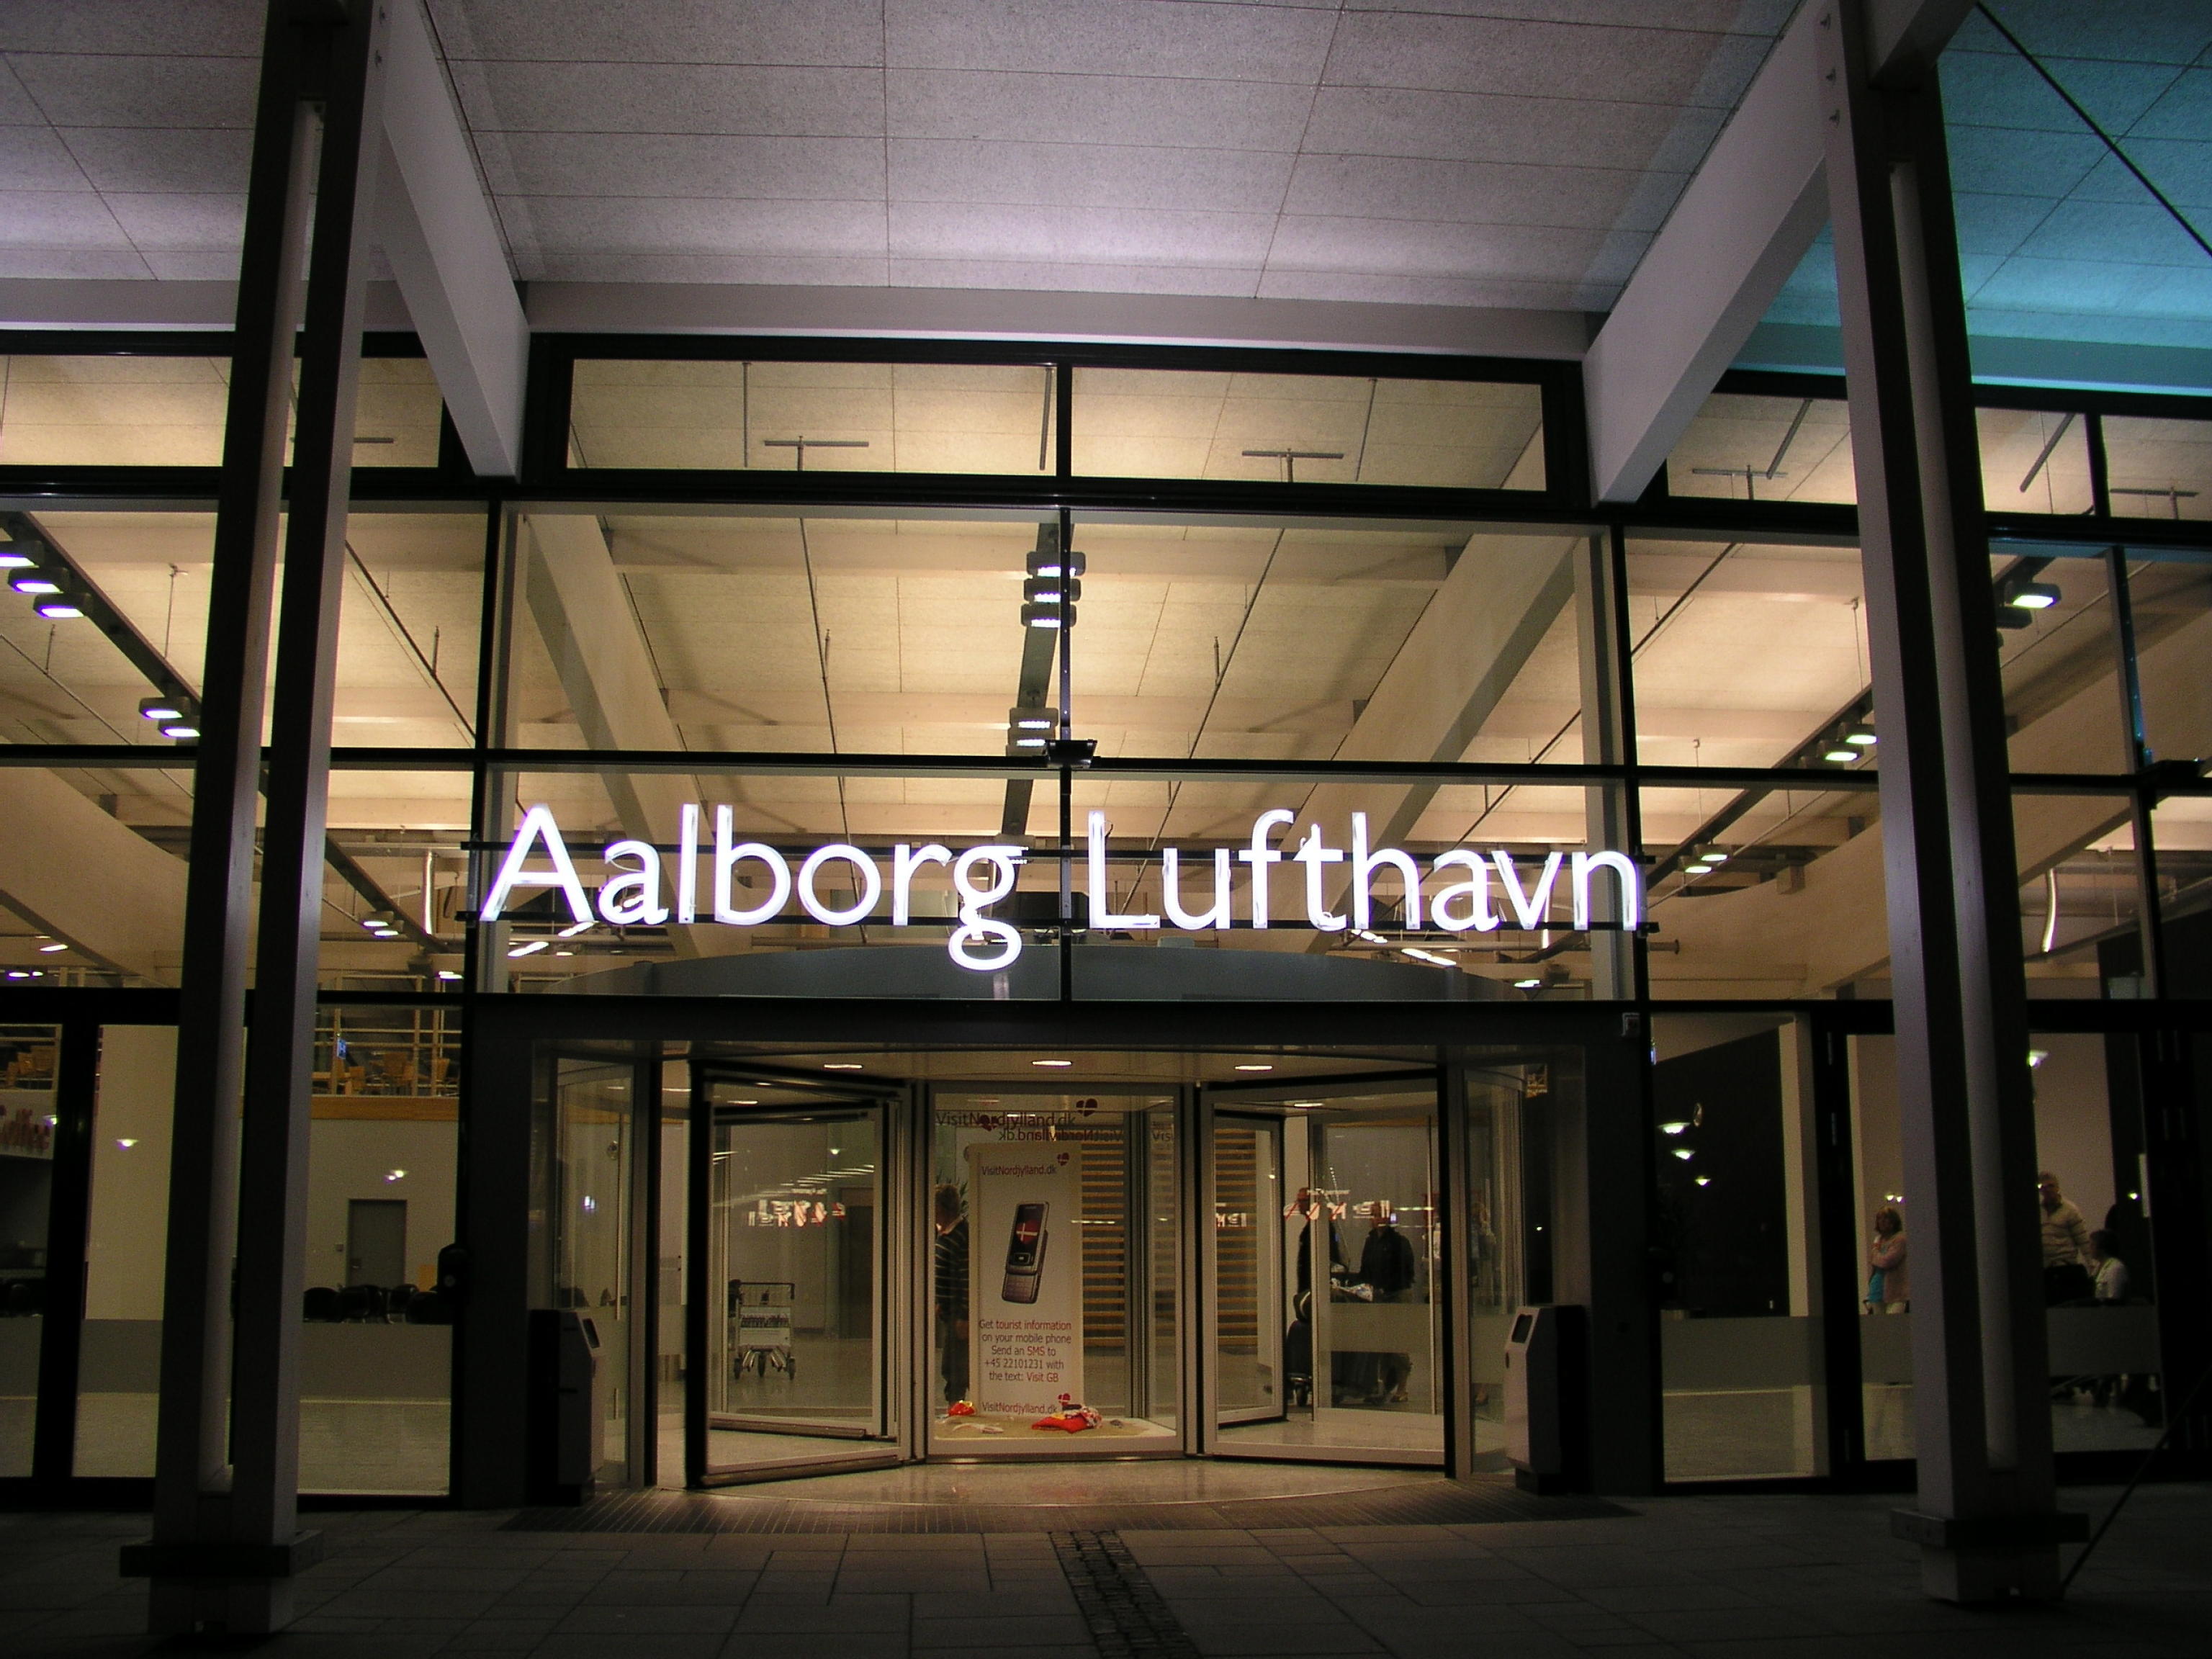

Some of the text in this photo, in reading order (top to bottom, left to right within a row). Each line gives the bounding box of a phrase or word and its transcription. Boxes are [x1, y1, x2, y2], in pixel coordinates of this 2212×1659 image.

[480, 803, 1640, 971] Aalborg Lufthavn
[981, 1165, 1057, 1177] VisitNordjylland.dk
[979, 1319, 1071, 1331] Get tourist information
[995, 1334, 1013, 1344] your
[1015, 1333, 1043, 1343] mobile
[1046, 1334, 1071, 1344] phone
[991, 1345, 1056, 1357] Send an SMS to
[984, 1358, 1064, 1370] +45 22101231 with
[989, 1371, 1059, 1382] the text: Visit GB
[981, 1401, 1057, 1415] VisitNordjylland.dk
